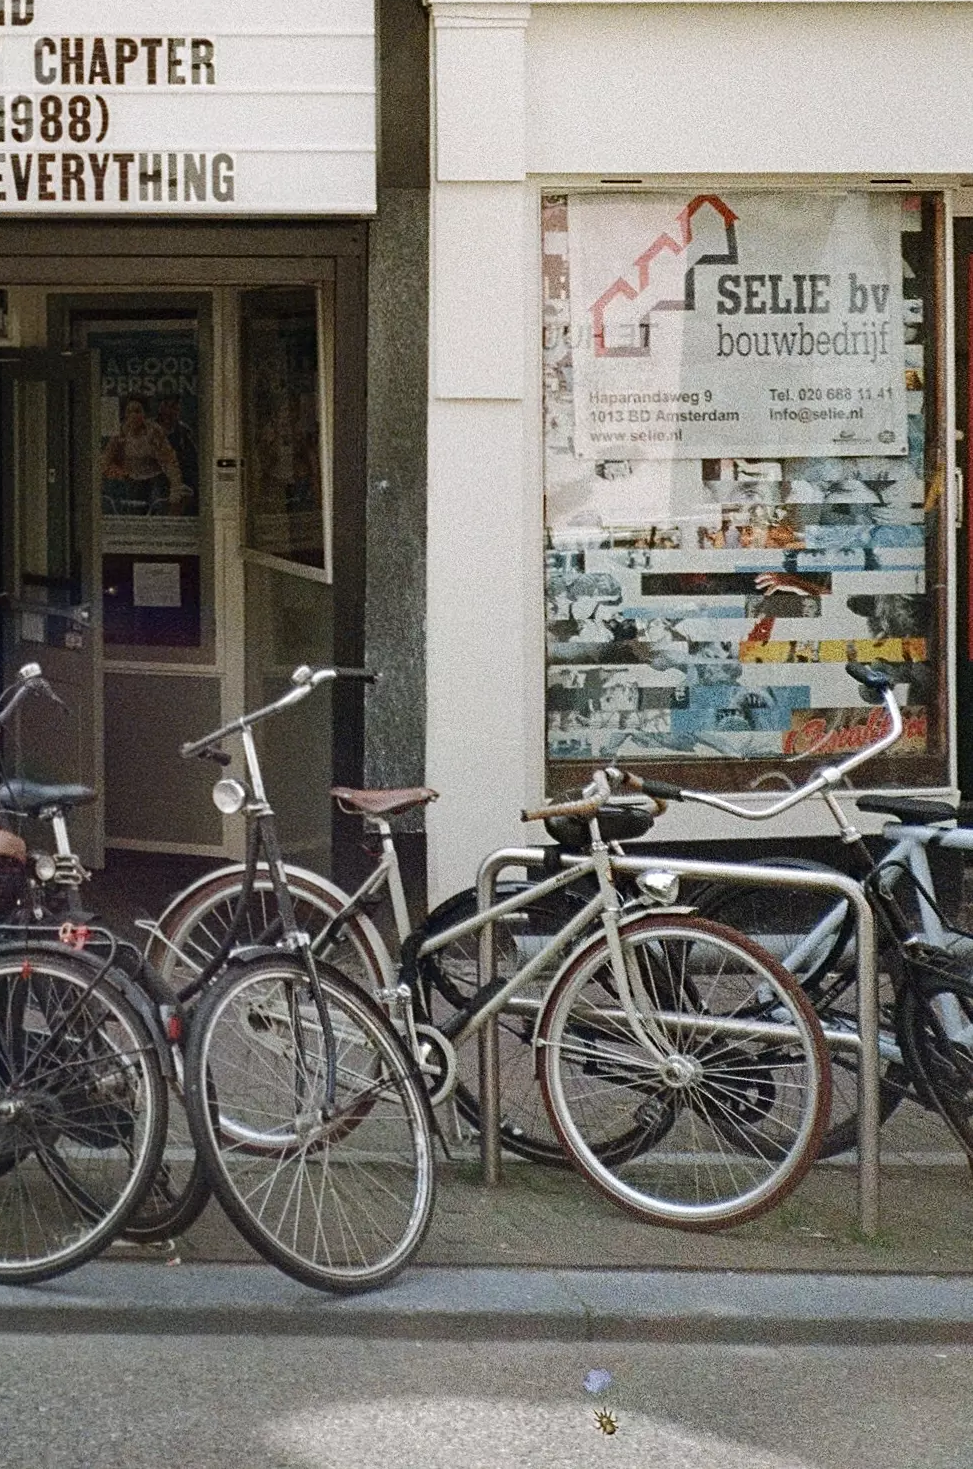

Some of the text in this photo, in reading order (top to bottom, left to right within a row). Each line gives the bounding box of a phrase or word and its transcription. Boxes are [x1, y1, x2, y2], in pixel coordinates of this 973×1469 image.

[33, 36, 216, 85] CHAPTER
[716, 272, 890, 316] SELIE bv
[716, 321, 889, 363] bouwbedrijf
[106, 356, 195, 375] A GOOD
[102, 376, 198, 396] PERSON
[769, 388, 794, 401] Tel.
[798, 387, 823, 401] 020
[704, 389, 713, 403] 9
[590, 410, 624, 423] 1013
[655, 409, 740, 423] Amsterdam
[590, 429, 683, 442] www.selie.nl
